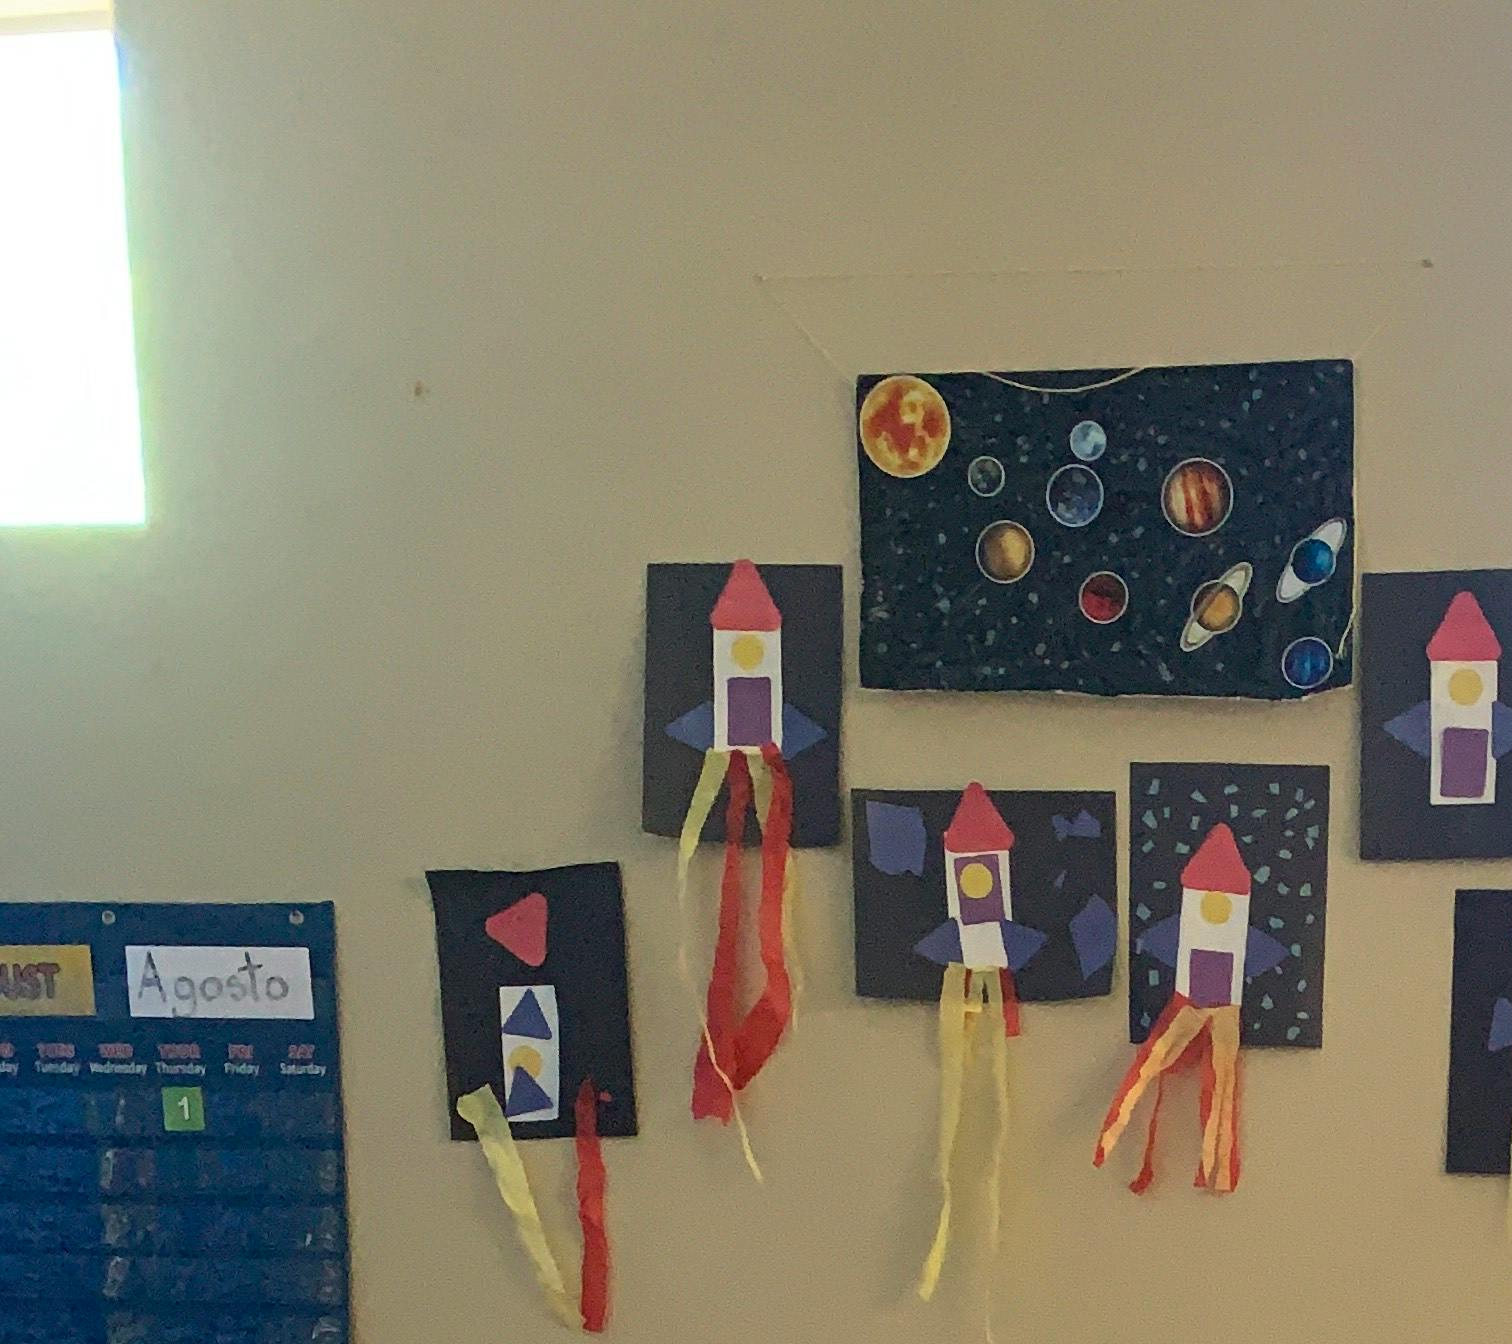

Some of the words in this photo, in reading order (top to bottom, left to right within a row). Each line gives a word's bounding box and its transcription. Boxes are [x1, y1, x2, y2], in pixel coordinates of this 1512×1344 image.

[138, 951, 289, 1018] Agosto
[35, 1061, 80, 1076] Tuesday
[90, 1061, 147, 1076] Wednesday
[156, 1062, 206, 1076] Thursday
[224, 1062, 260, 1077] Friday
[280, 1062, 327, 1077] Saturday
[178, 1096, 189, 1121] 1
